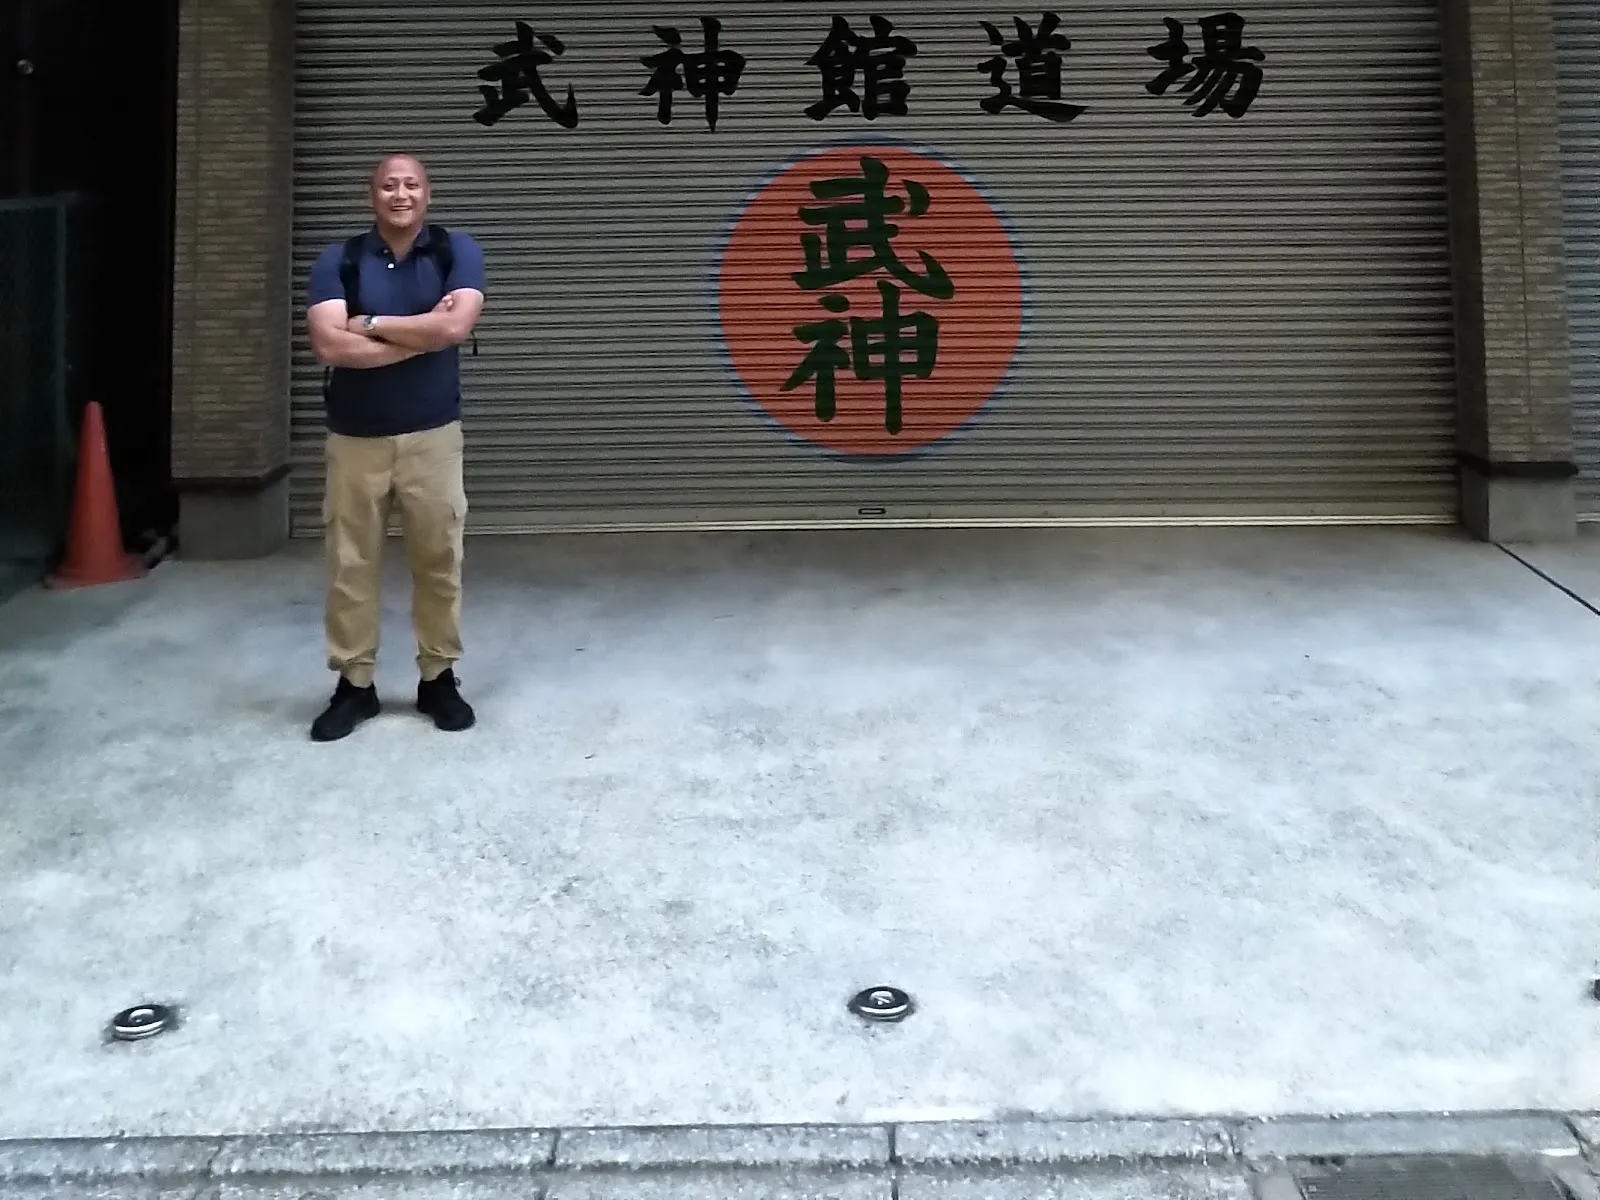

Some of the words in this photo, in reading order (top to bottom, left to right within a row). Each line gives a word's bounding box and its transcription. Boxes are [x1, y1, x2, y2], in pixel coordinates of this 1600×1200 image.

[473, 11, 1266, 133] 武神館道場
[779, 156, 955, 436] 武神
